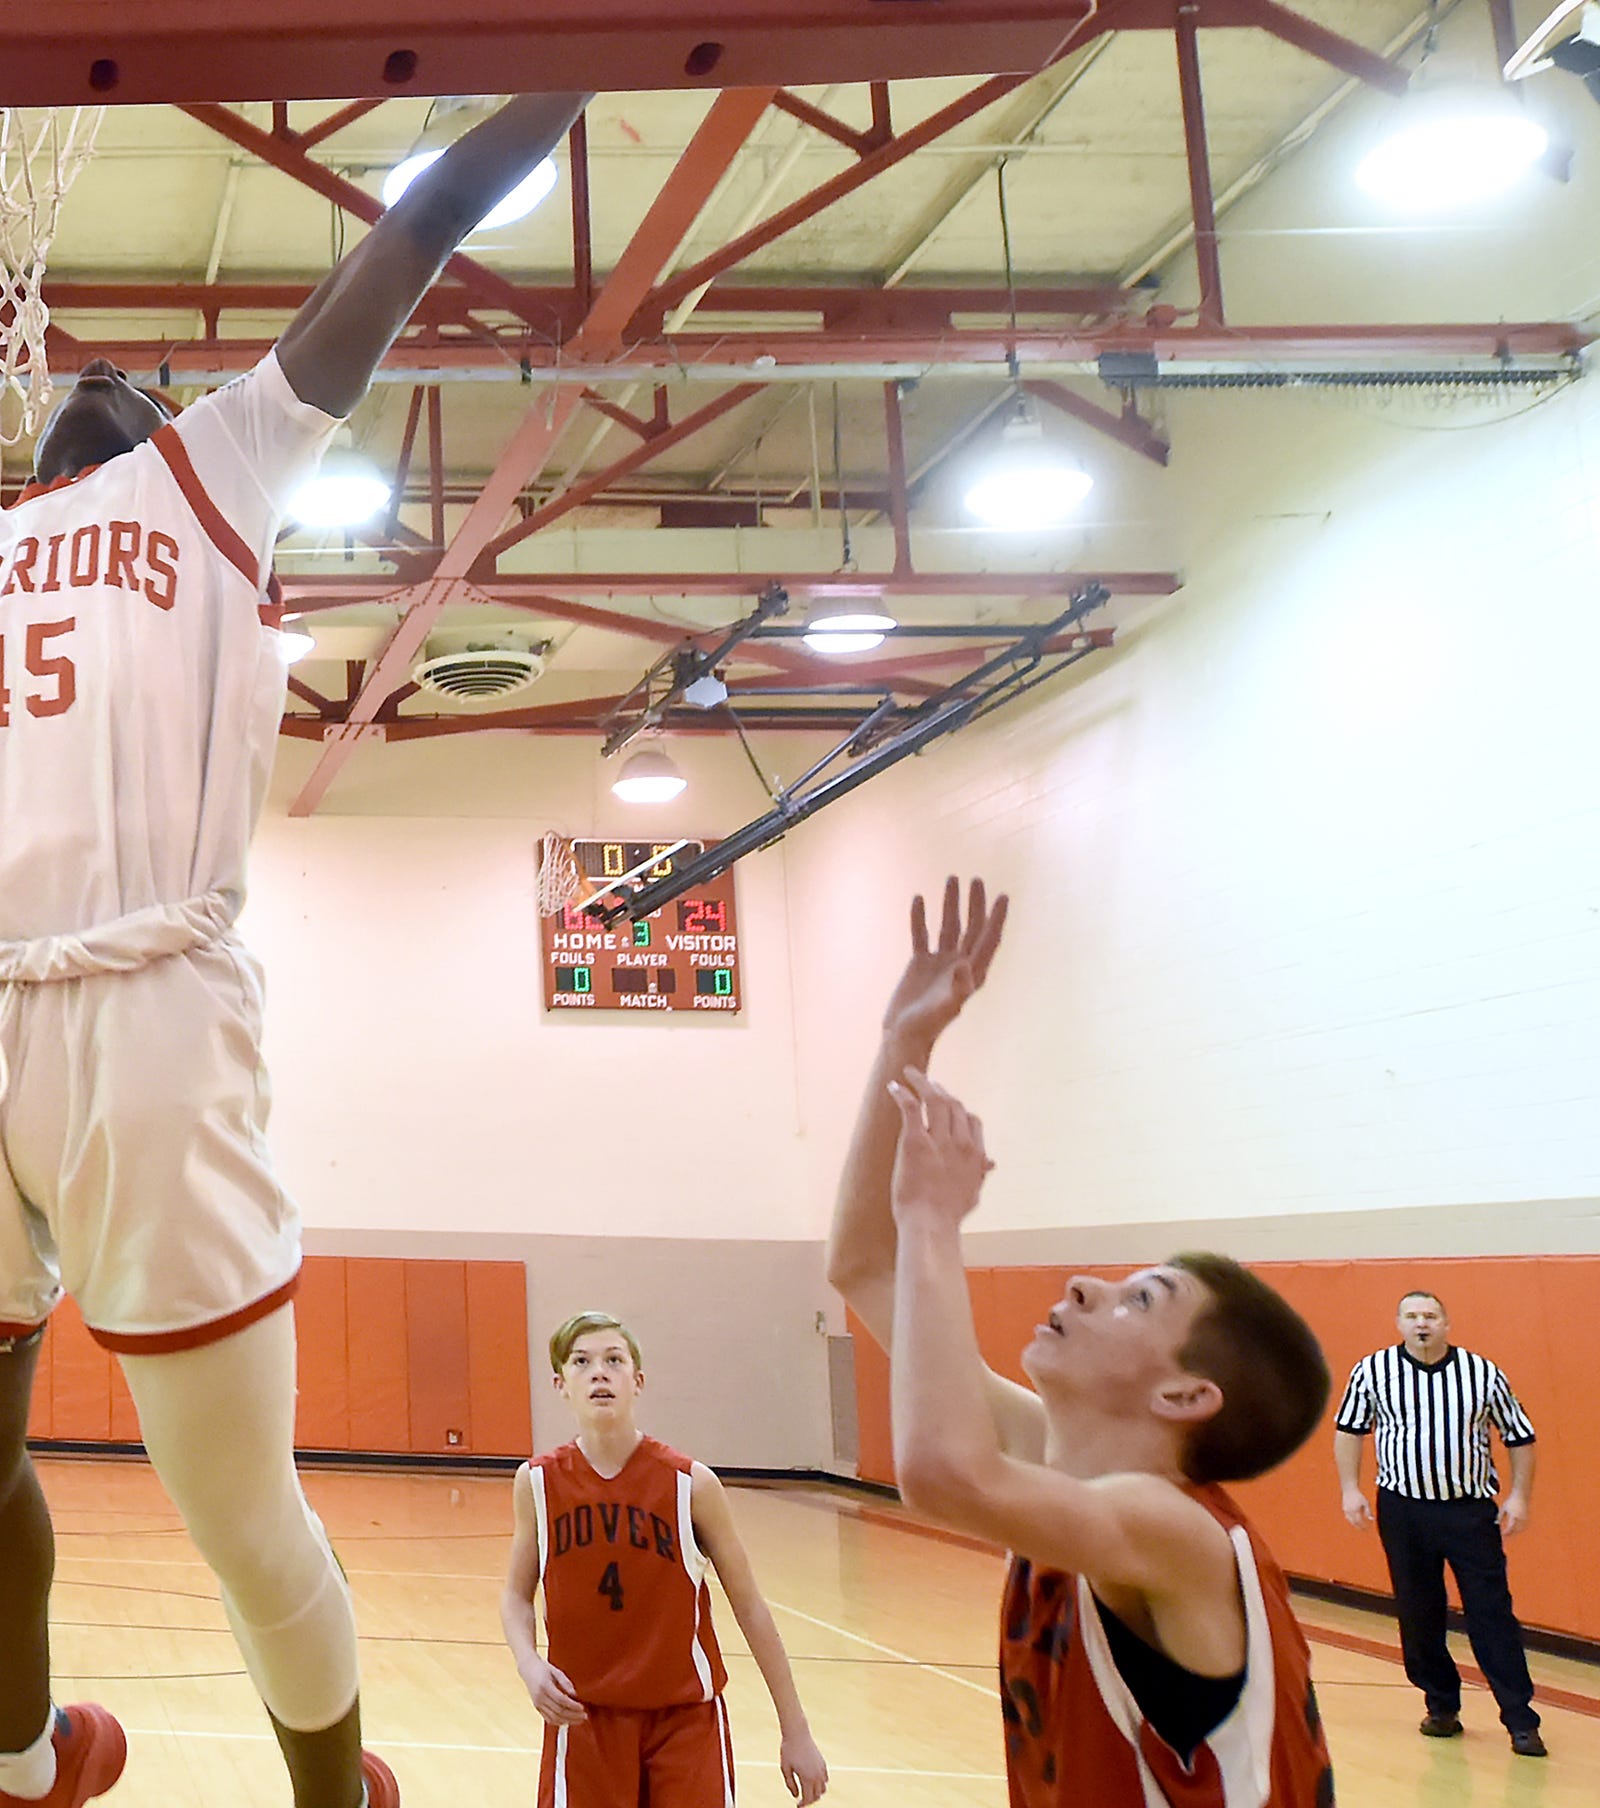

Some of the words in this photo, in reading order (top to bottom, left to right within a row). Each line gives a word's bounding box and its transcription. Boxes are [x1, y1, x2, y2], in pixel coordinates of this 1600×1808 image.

[684, 900, 726, 932] 24
[553, 933, 617, 950] HOME
[633, 921, 650, 947] 3
[665, 935, 736, 951] VISITOR
[550, 951, 595, 965] FOULS
[616, 953, 668, 967] PLAYER
[690, 953, 735, 967] FOULS
[573, 967, 590, 993] 0
[714, 969, 731, 995] 0
[553, 993, 595, 1006] POINTS
[619, 994, 667, 1008] MATCH
[693, 995, 736, 1009] POINTS
[555, 1503, 675, 1562] DOVER
[598, 1561, 623, 1611] 4
